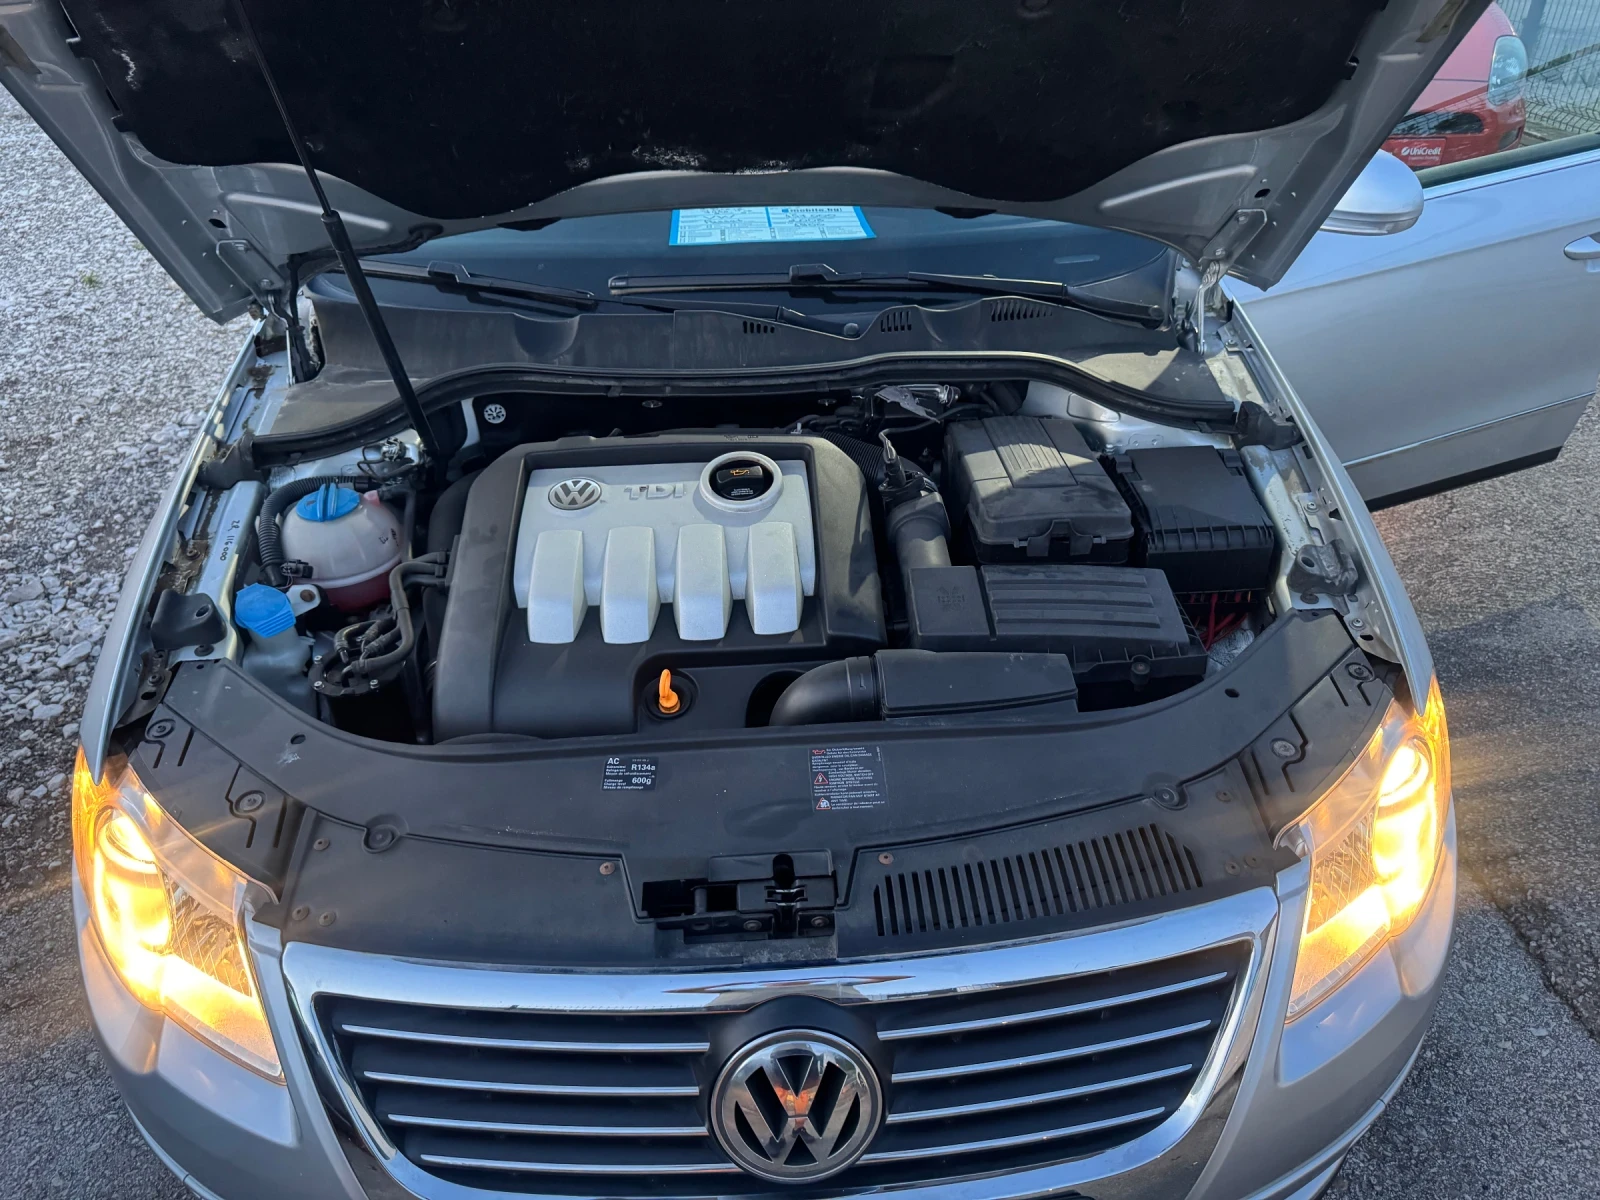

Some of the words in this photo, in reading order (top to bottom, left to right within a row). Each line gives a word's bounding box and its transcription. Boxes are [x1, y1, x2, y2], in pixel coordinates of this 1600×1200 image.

[1410, 147, 1441, 155] UniCredit
[548, 477, 602, 510] VW
[624, 483, 685, 501] TDI
[631, 777, 652, 785] 600g
[714, 1032, 880, 1179] VW
